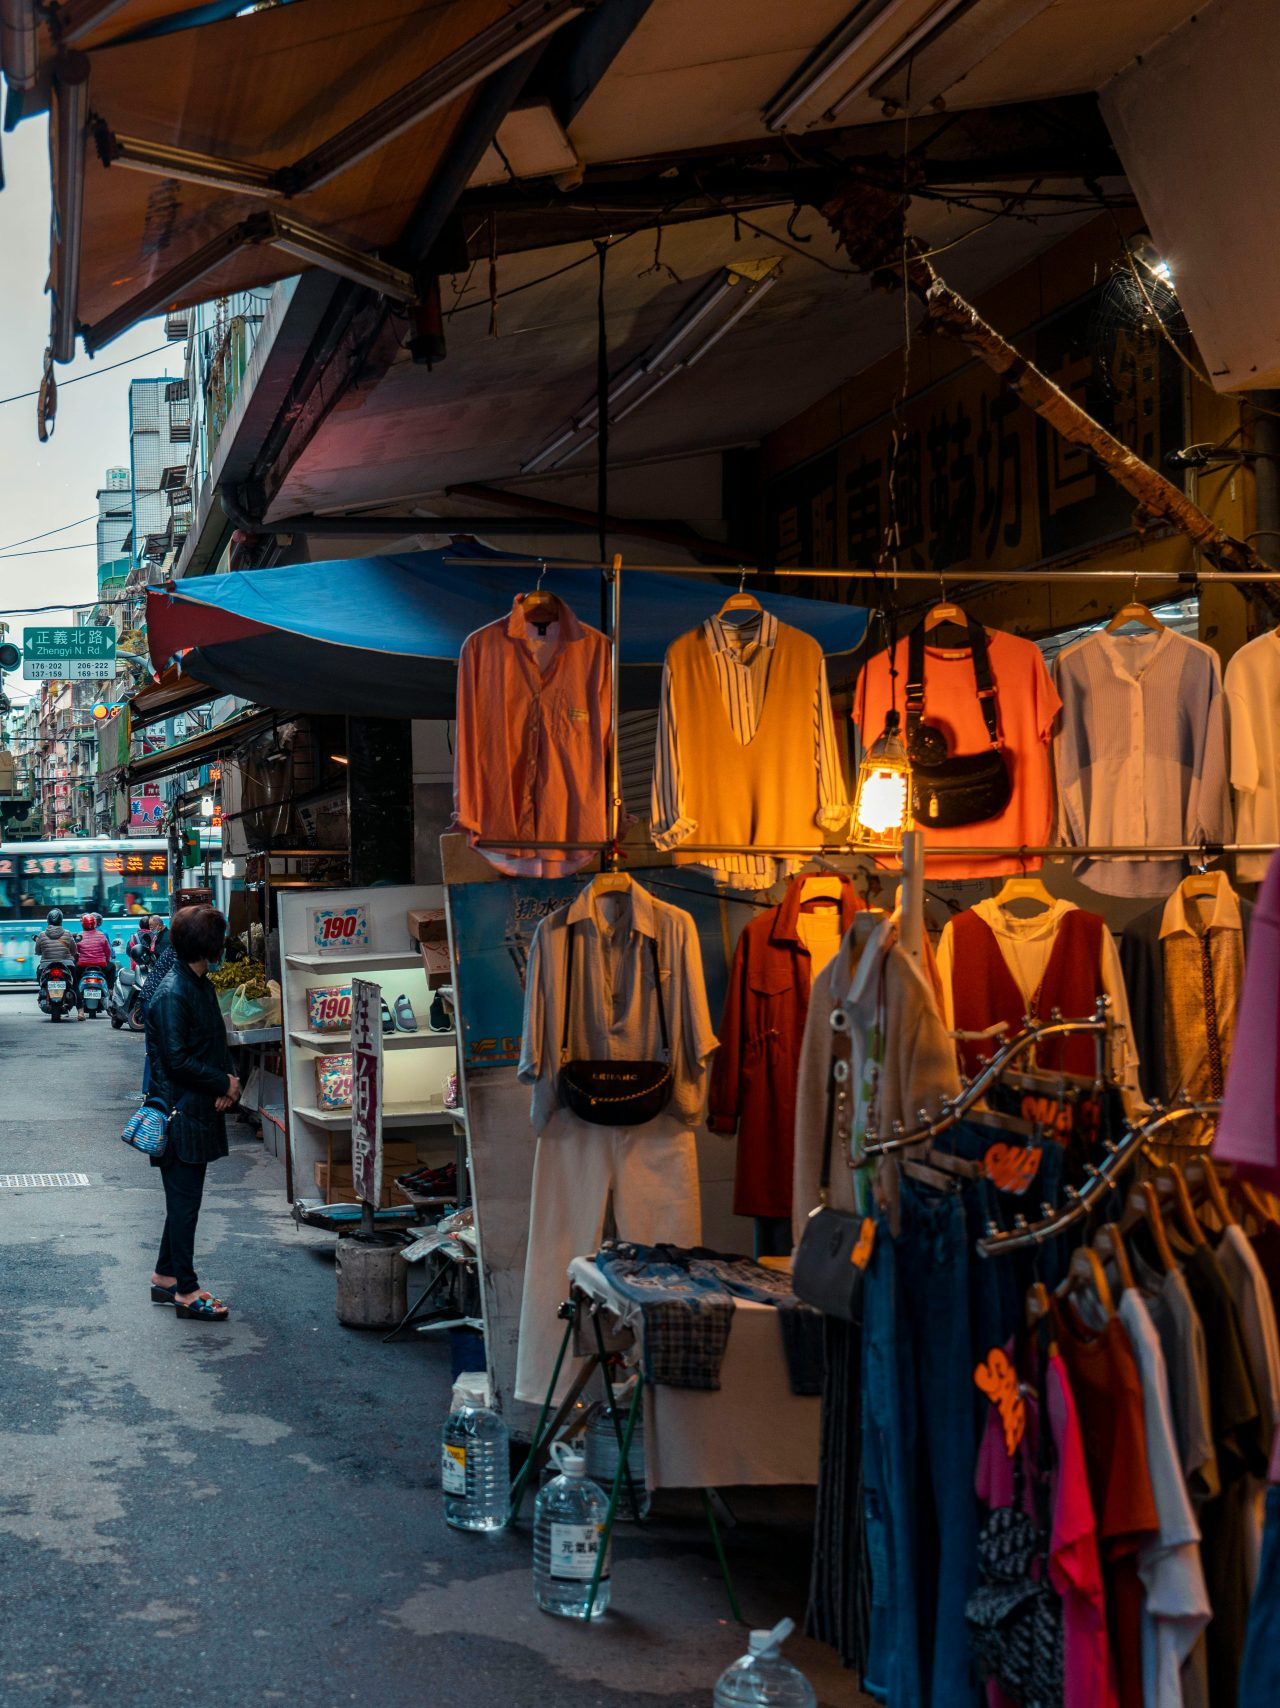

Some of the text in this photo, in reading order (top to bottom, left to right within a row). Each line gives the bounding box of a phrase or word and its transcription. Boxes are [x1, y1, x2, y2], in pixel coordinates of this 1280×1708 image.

[35, 631, 103, 645] 正義北路
[37, 647, 72, 656] Zhengyi
[87, 646, 103, 654] Rd.
[514, 896, 573, 920] 排水
[328, 1077, 352, 1098] $29
[561, 1541, 598, 1553] 元氣純
